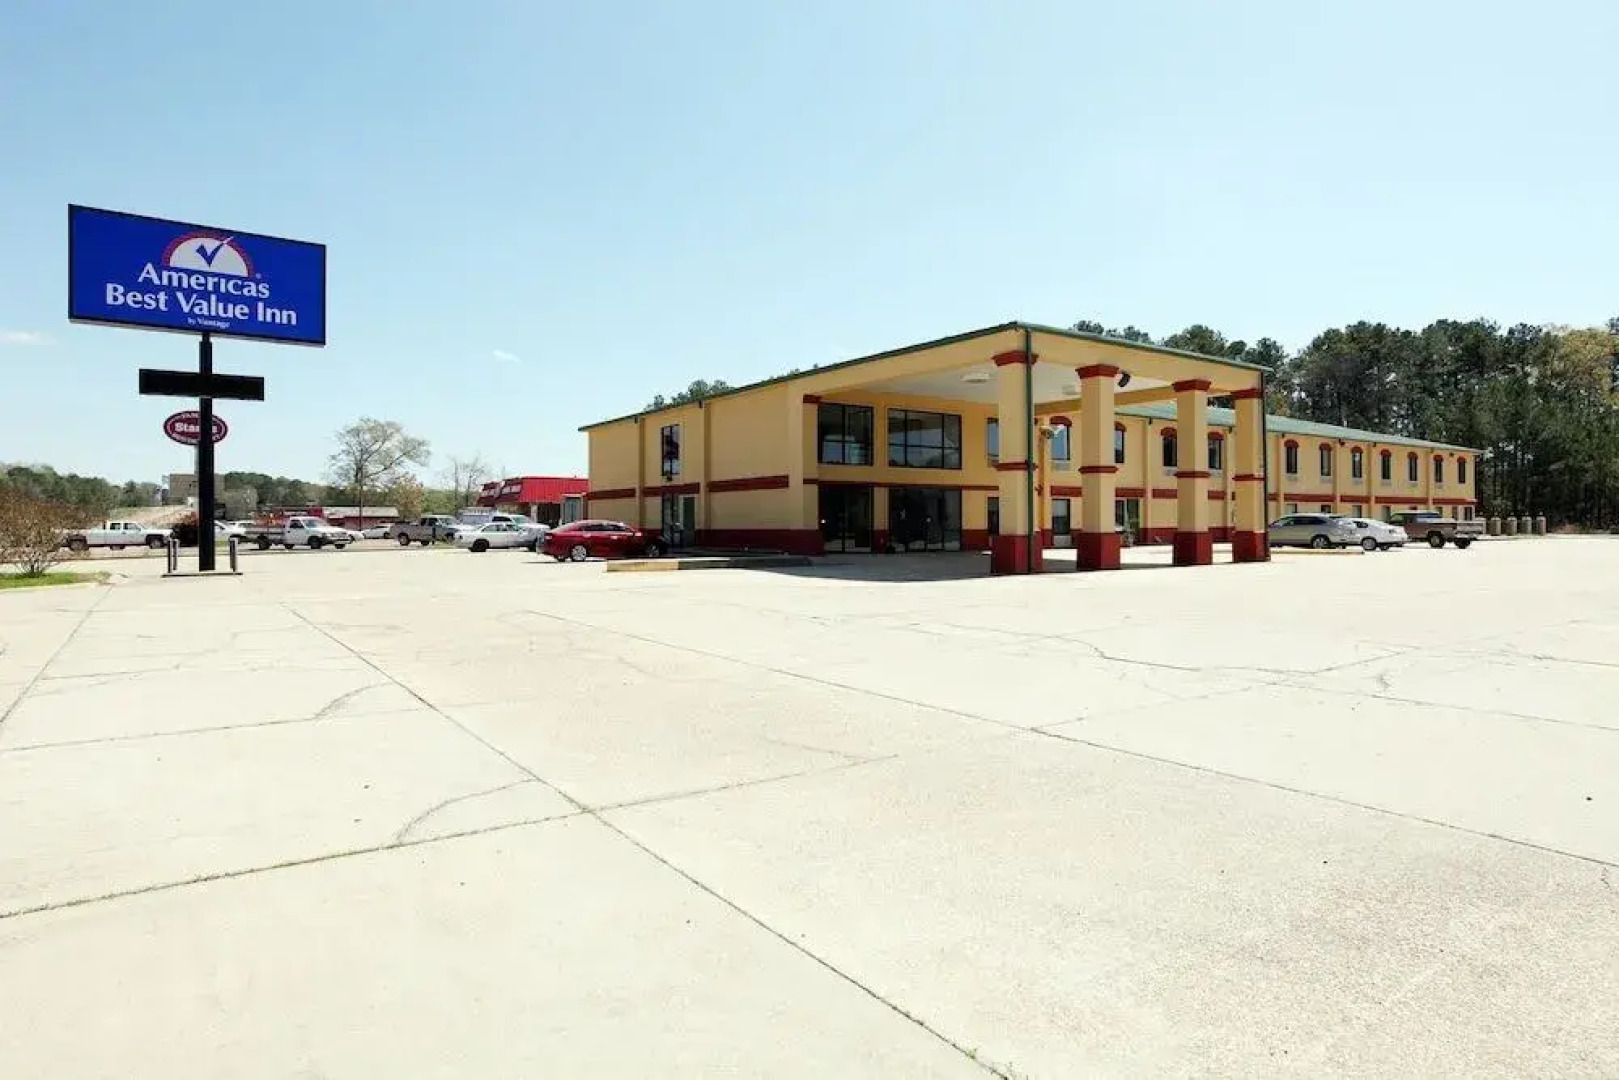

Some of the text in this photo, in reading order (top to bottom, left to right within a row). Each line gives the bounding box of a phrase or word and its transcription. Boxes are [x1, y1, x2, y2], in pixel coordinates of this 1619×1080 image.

[138, 262, 270, 299] Americas
[106, 283, 297, 325] Best Value Inn
